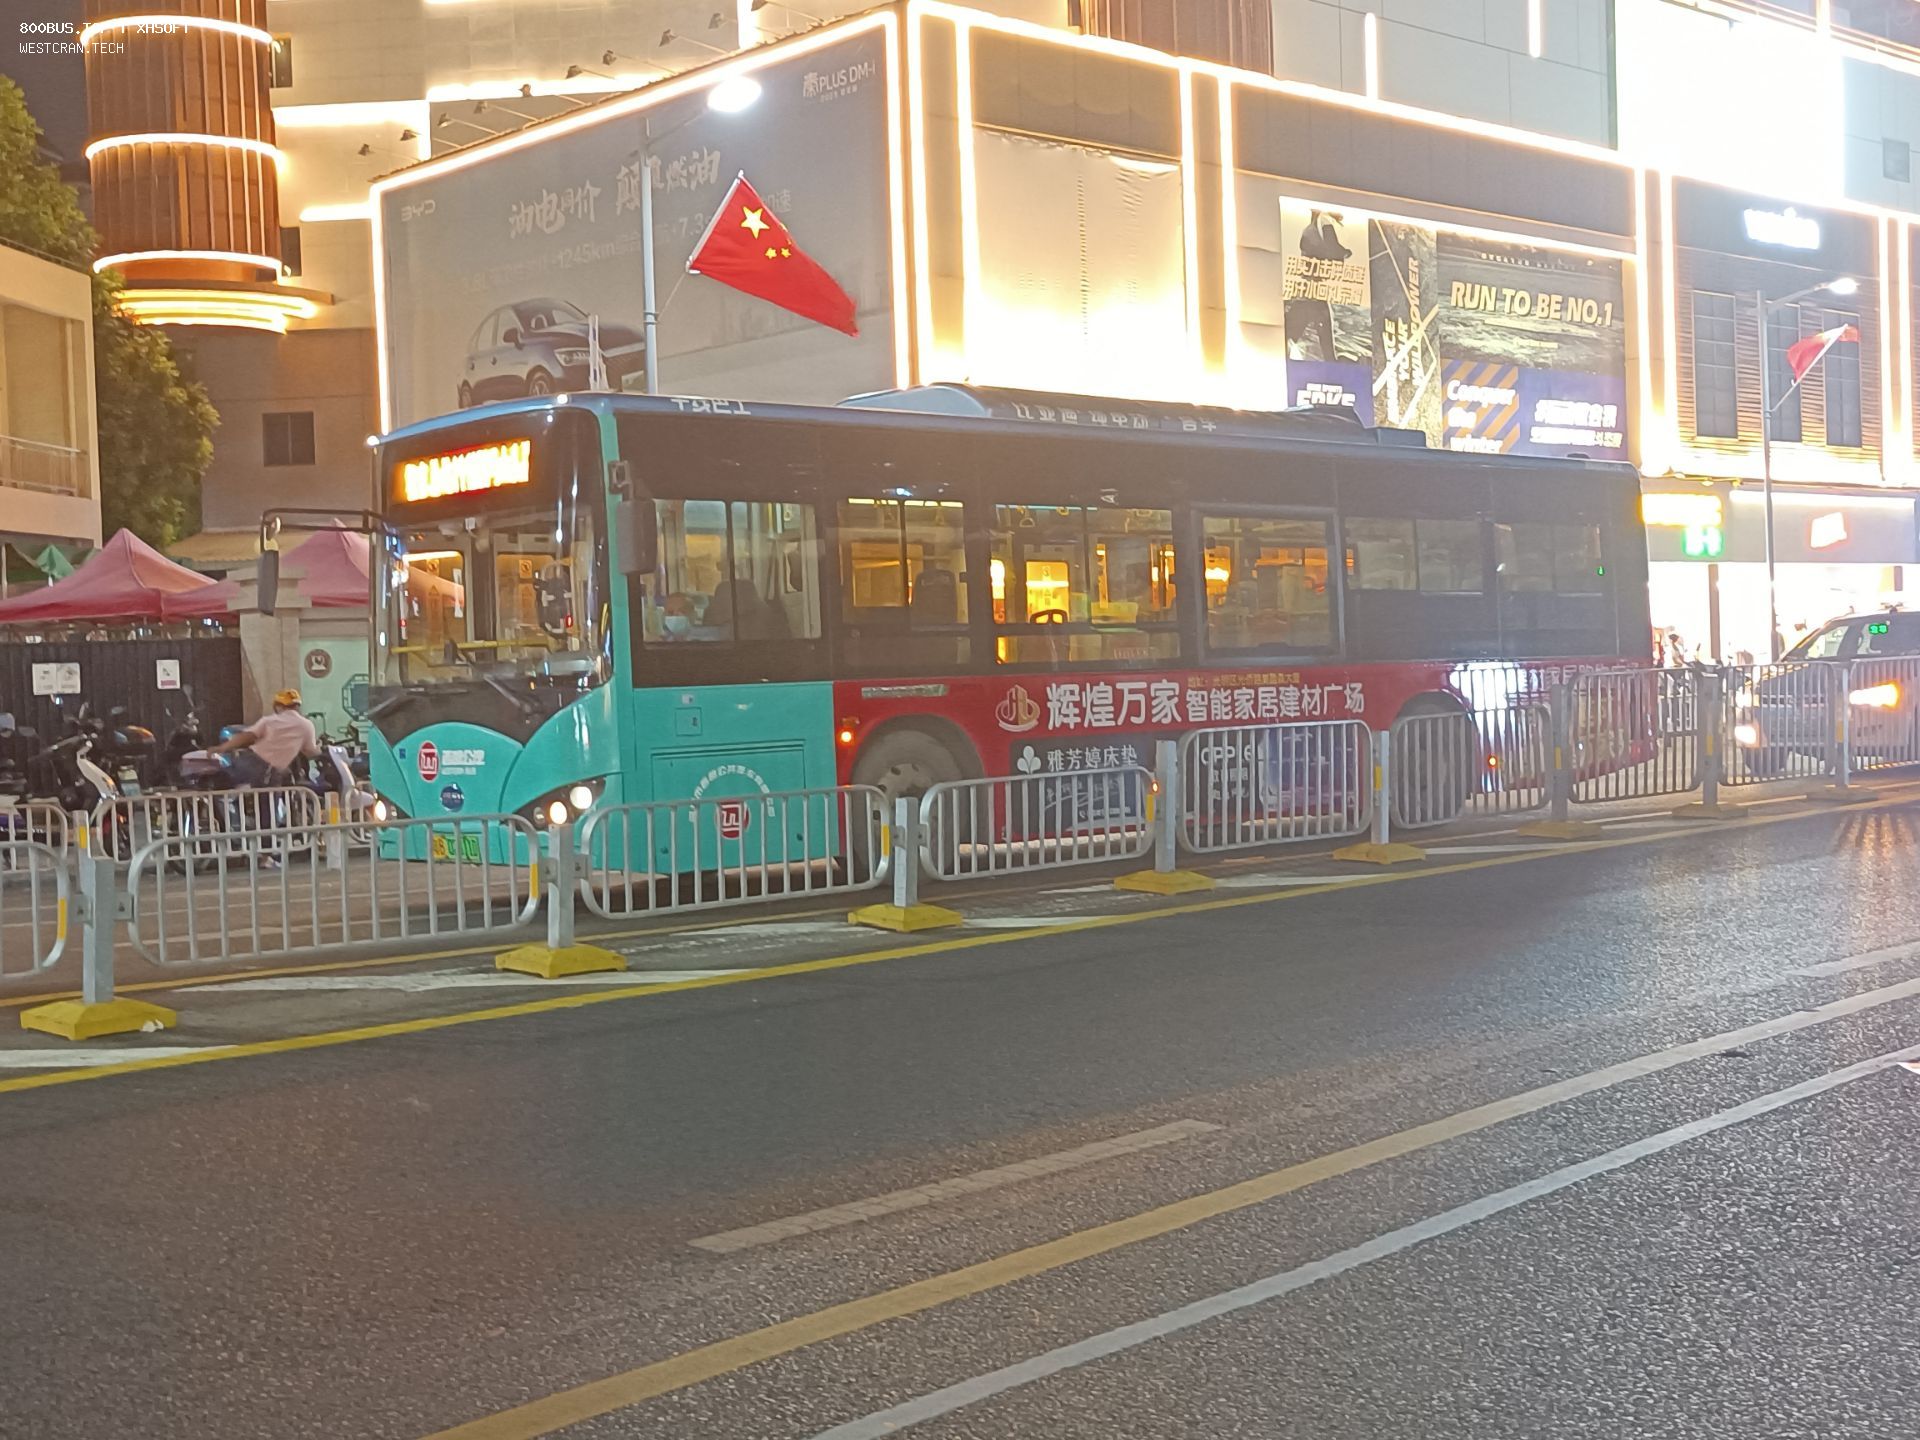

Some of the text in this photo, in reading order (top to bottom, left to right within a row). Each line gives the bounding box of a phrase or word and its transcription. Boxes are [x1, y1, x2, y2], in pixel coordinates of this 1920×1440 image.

[1451, 281, 1497, 312] RUN
[1502, 288, 1531, 317] TO
[1536, 292, 1563, 320] BE
[1567, 296, 1613, 327] NO.1
[1046, 679, 1366, 731] 辉煌万家 智能家居建材广场
[1047, 744, 1138, 772] 雅芳婷床垫
